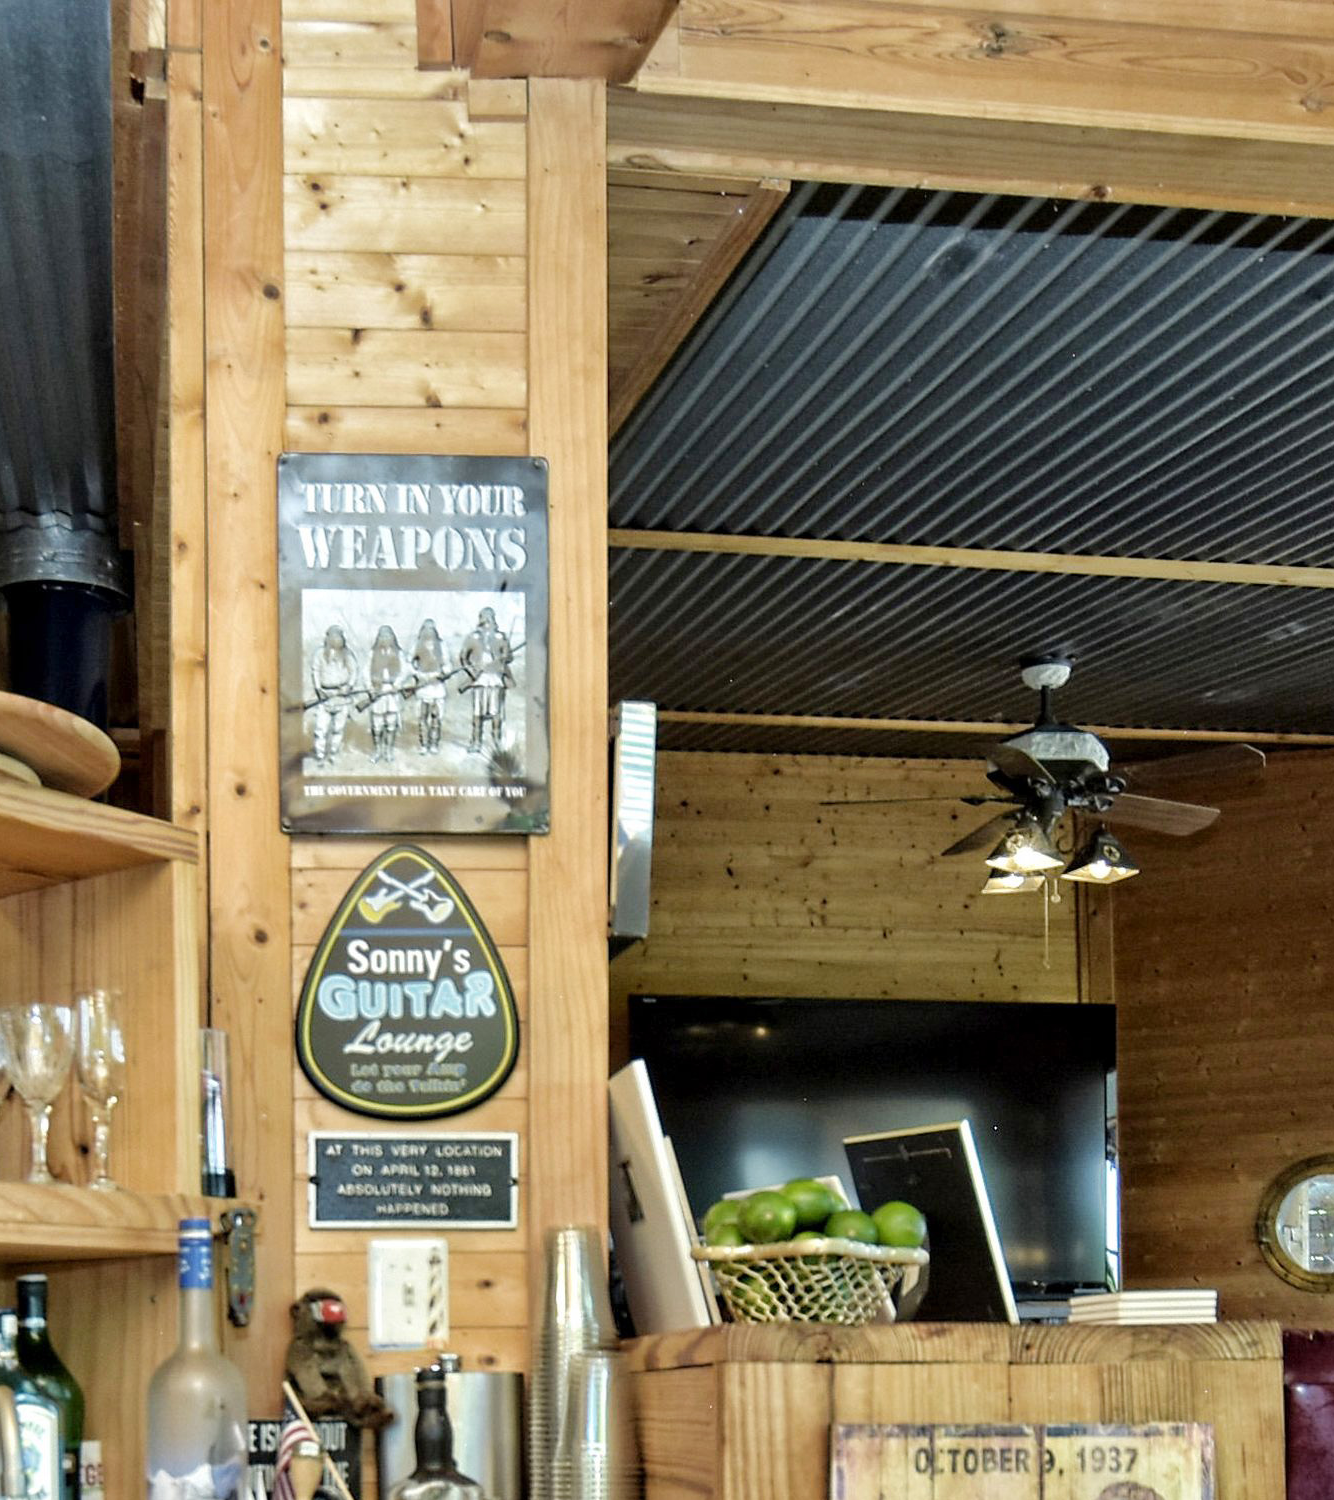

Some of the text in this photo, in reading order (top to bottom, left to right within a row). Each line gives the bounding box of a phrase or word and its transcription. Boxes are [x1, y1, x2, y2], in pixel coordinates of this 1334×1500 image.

[302, 482, 528, 517] TURN IN YOUR
[298, 525, 527, 572] WEAPONS
[303, 785, 528, 797] THE GOVERNMENT WILL TAKE CARE OF YOU
[346, 938, 471, 980] Sonny's
[317, 971, 497, 1021] GUITAR
[343, 1021, 474, 1063] Lounge
[325, 1144, 503, 1158] AT THIS VERY LOCATION
[351, 1164, 373, 1177] ON
[380, 1164, 420, 1177] APRIL
[337, 1184, 492, 1197] ABSOLUTELY NOTHING
[376, 1202, 450, 1216] HAPPENED
[914, 1446, 1139, 1477] OCTOBER 9, 1937
